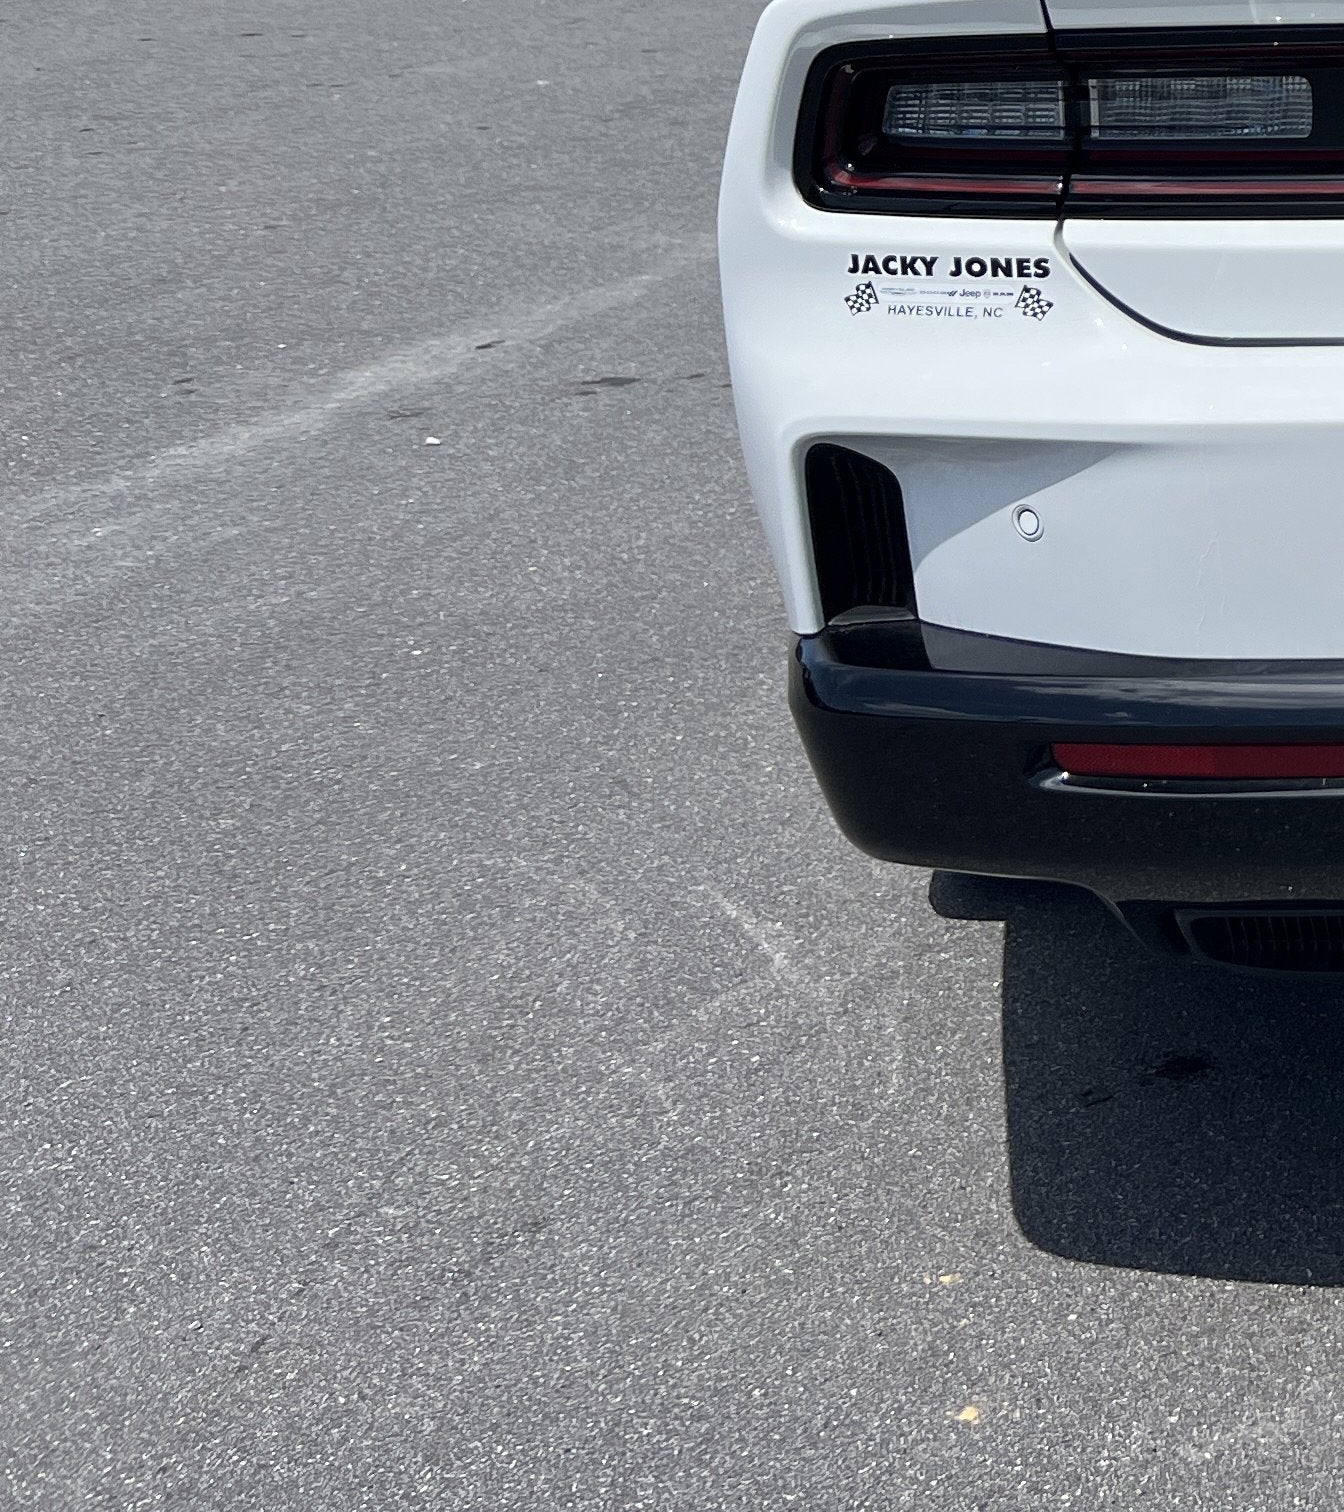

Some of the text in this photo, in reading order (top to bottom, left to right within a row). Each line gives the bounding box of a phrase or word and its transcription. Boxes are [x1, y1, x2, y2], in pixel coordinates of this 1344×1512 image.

[847, 253, 1051, 278] JACKY JONES
[960, 289, 981, 299] Jeep
[888, 304, 1004, 319] HAYESVILLE, NC
